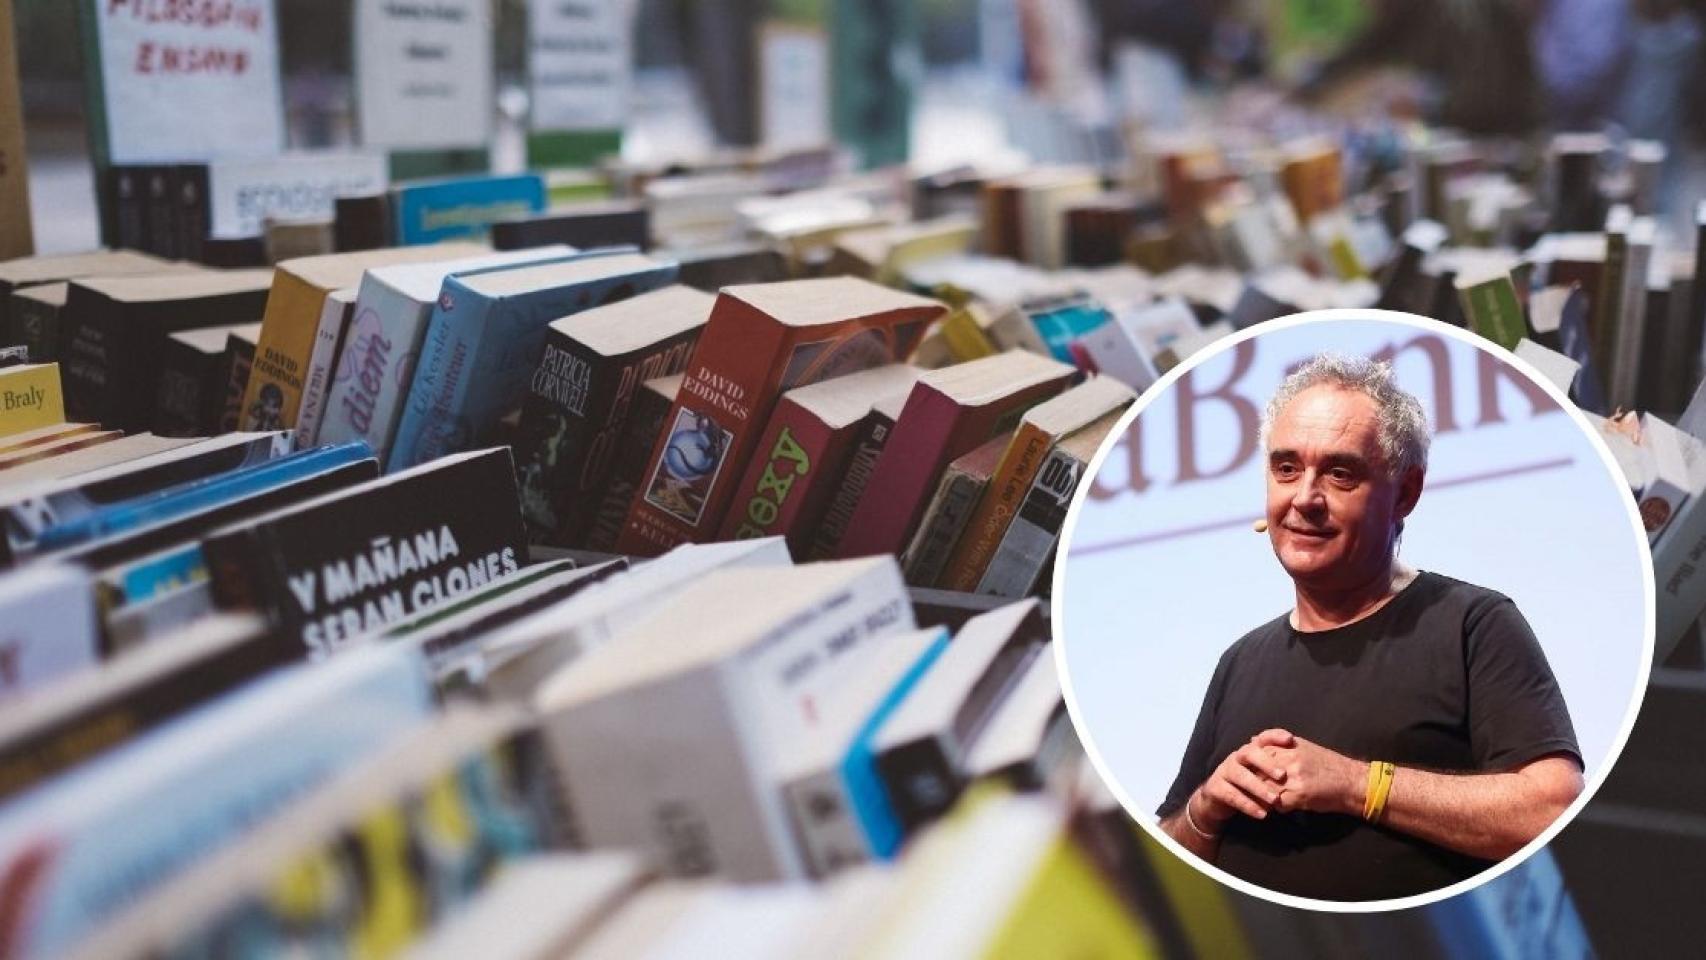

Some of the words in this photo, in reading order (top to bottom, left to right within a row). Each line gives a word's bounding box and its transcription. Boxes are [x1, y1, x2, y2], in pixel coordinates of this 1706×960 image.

[265, 346, 298, 373] DAVID
[541, 343, 591, 393] PATRICIA
[698, 366, 745, 400] DAVID
[4, 386, 45, 411] Braly
[342, 332, 392, 435] diem
[683, 375, 749, 420] EDDINGS
[287, 570, 316, 613] Y
[322, 525, 460, 605] MAÑANA
[411, 546, 519, 613] CLONES
